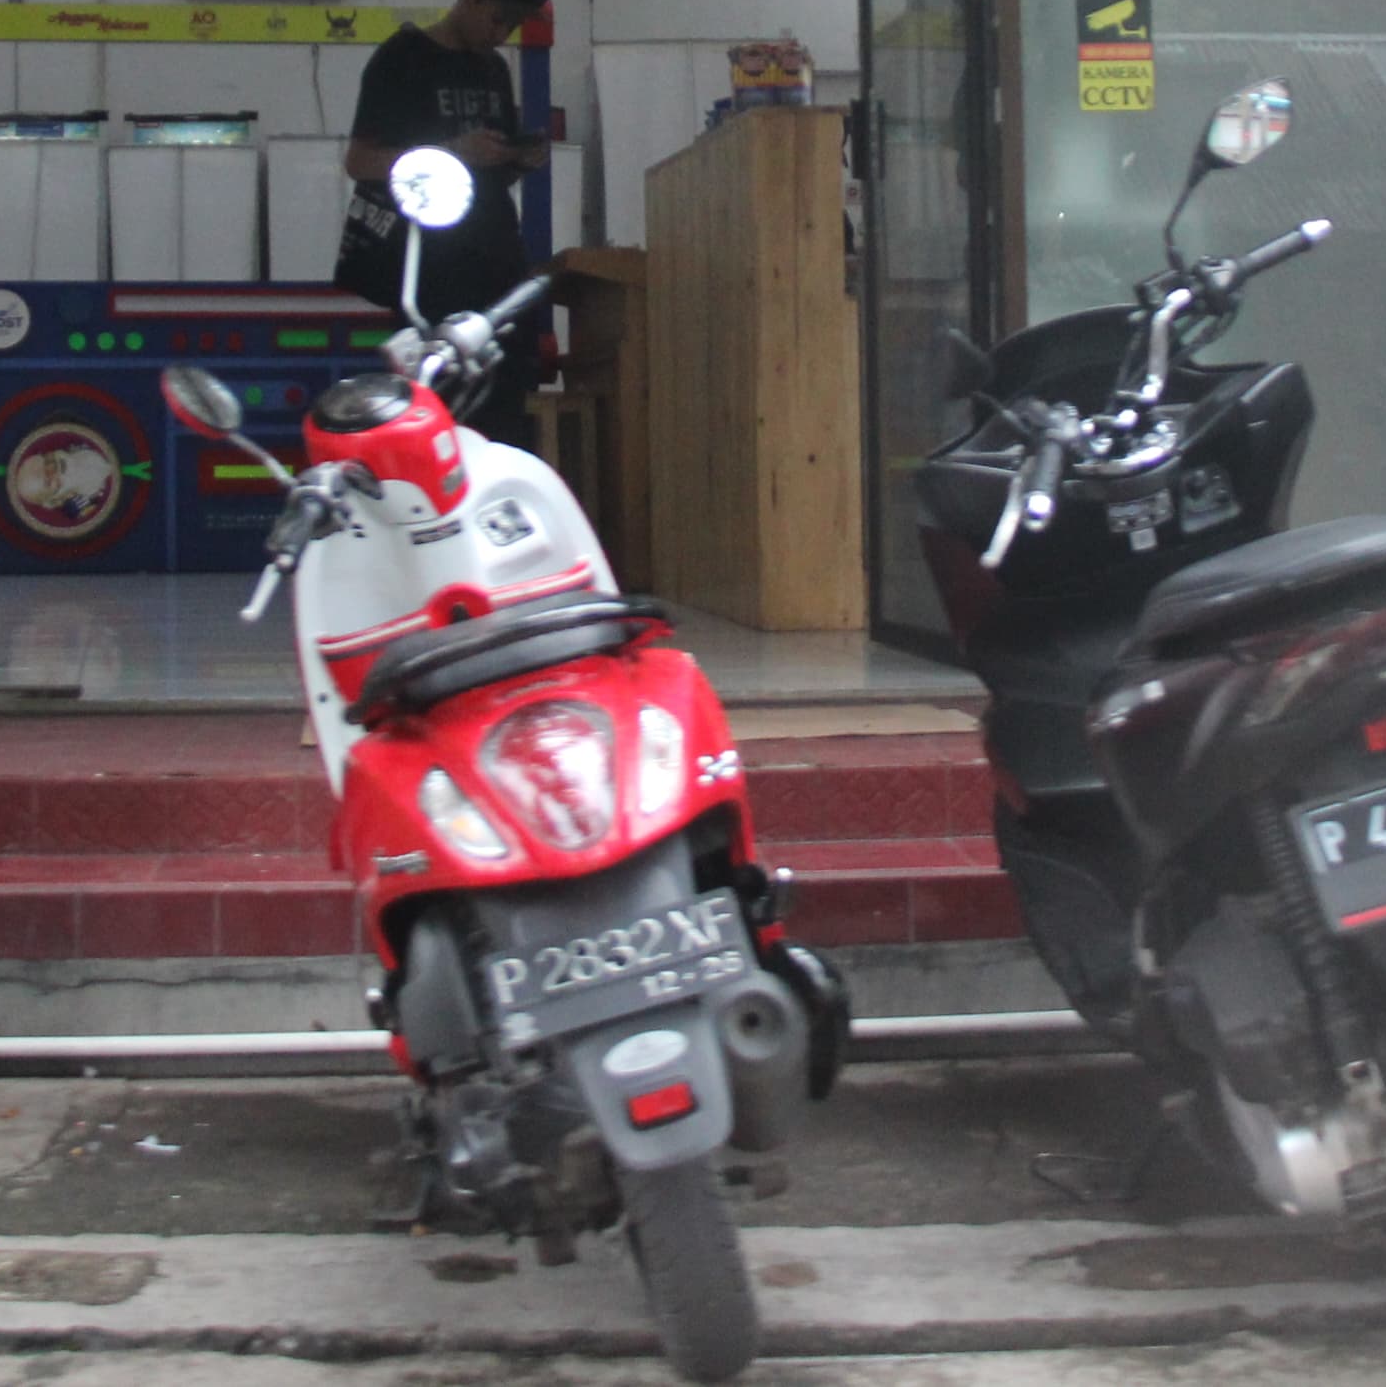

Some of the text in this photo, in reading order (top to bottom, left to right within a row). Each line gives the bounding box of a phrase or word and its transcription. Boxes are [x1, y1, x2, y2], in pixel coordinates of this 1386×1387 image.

[1082, 65, 1150, 80] KAMERA
[1082, 85, 1152, 107] CCTV
[1315, 820, 1346, 864] P
[491, 896, 734, 1003] P 2832 XF
